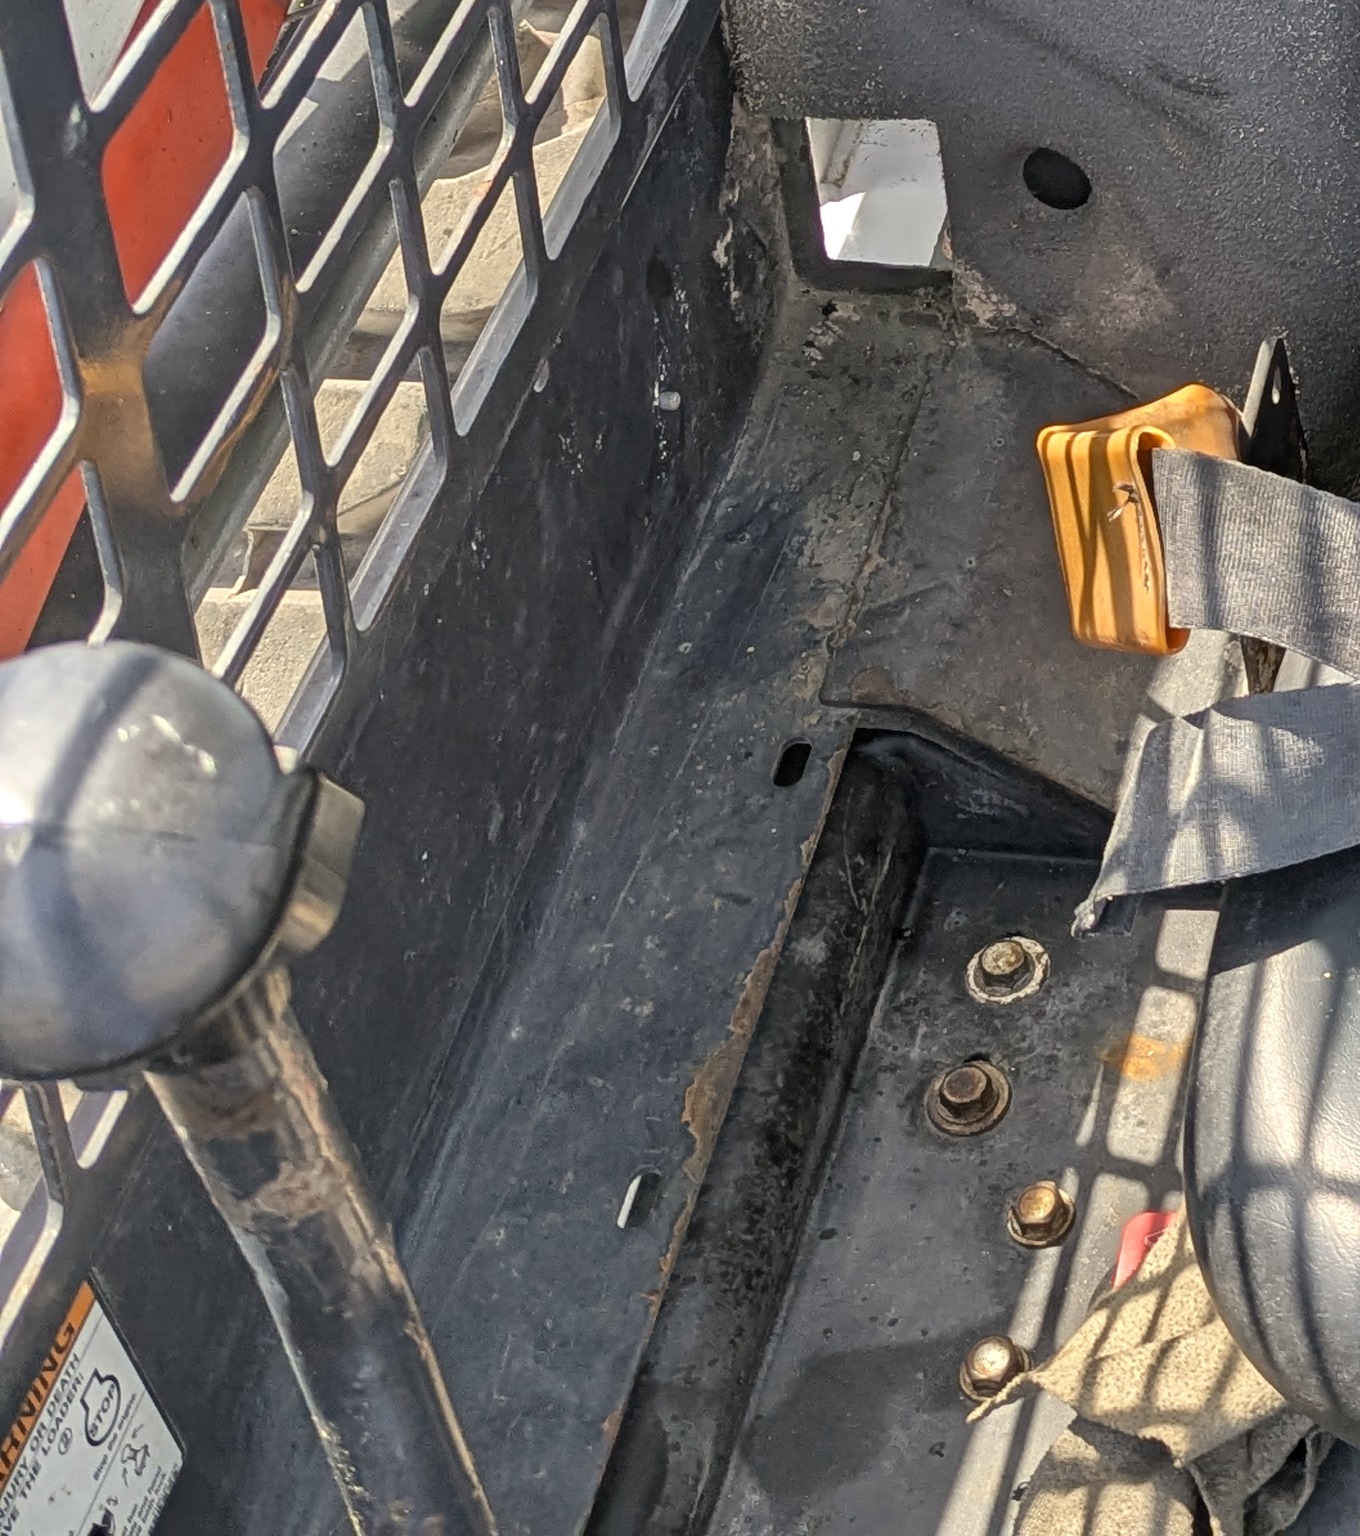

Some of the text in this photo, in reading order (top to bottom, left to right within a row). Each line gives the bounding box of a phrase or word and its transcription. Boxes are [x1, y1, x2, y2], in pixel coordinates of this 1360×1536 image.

[20, 1459, 42, 1499] THE
[41, 1370, 85, 1457] LOADER:
[29, 1421, 47, 1452] OR
[46, 1352, 80, 1417] DEATH
[89, 1383, 116, 1438] STOP
